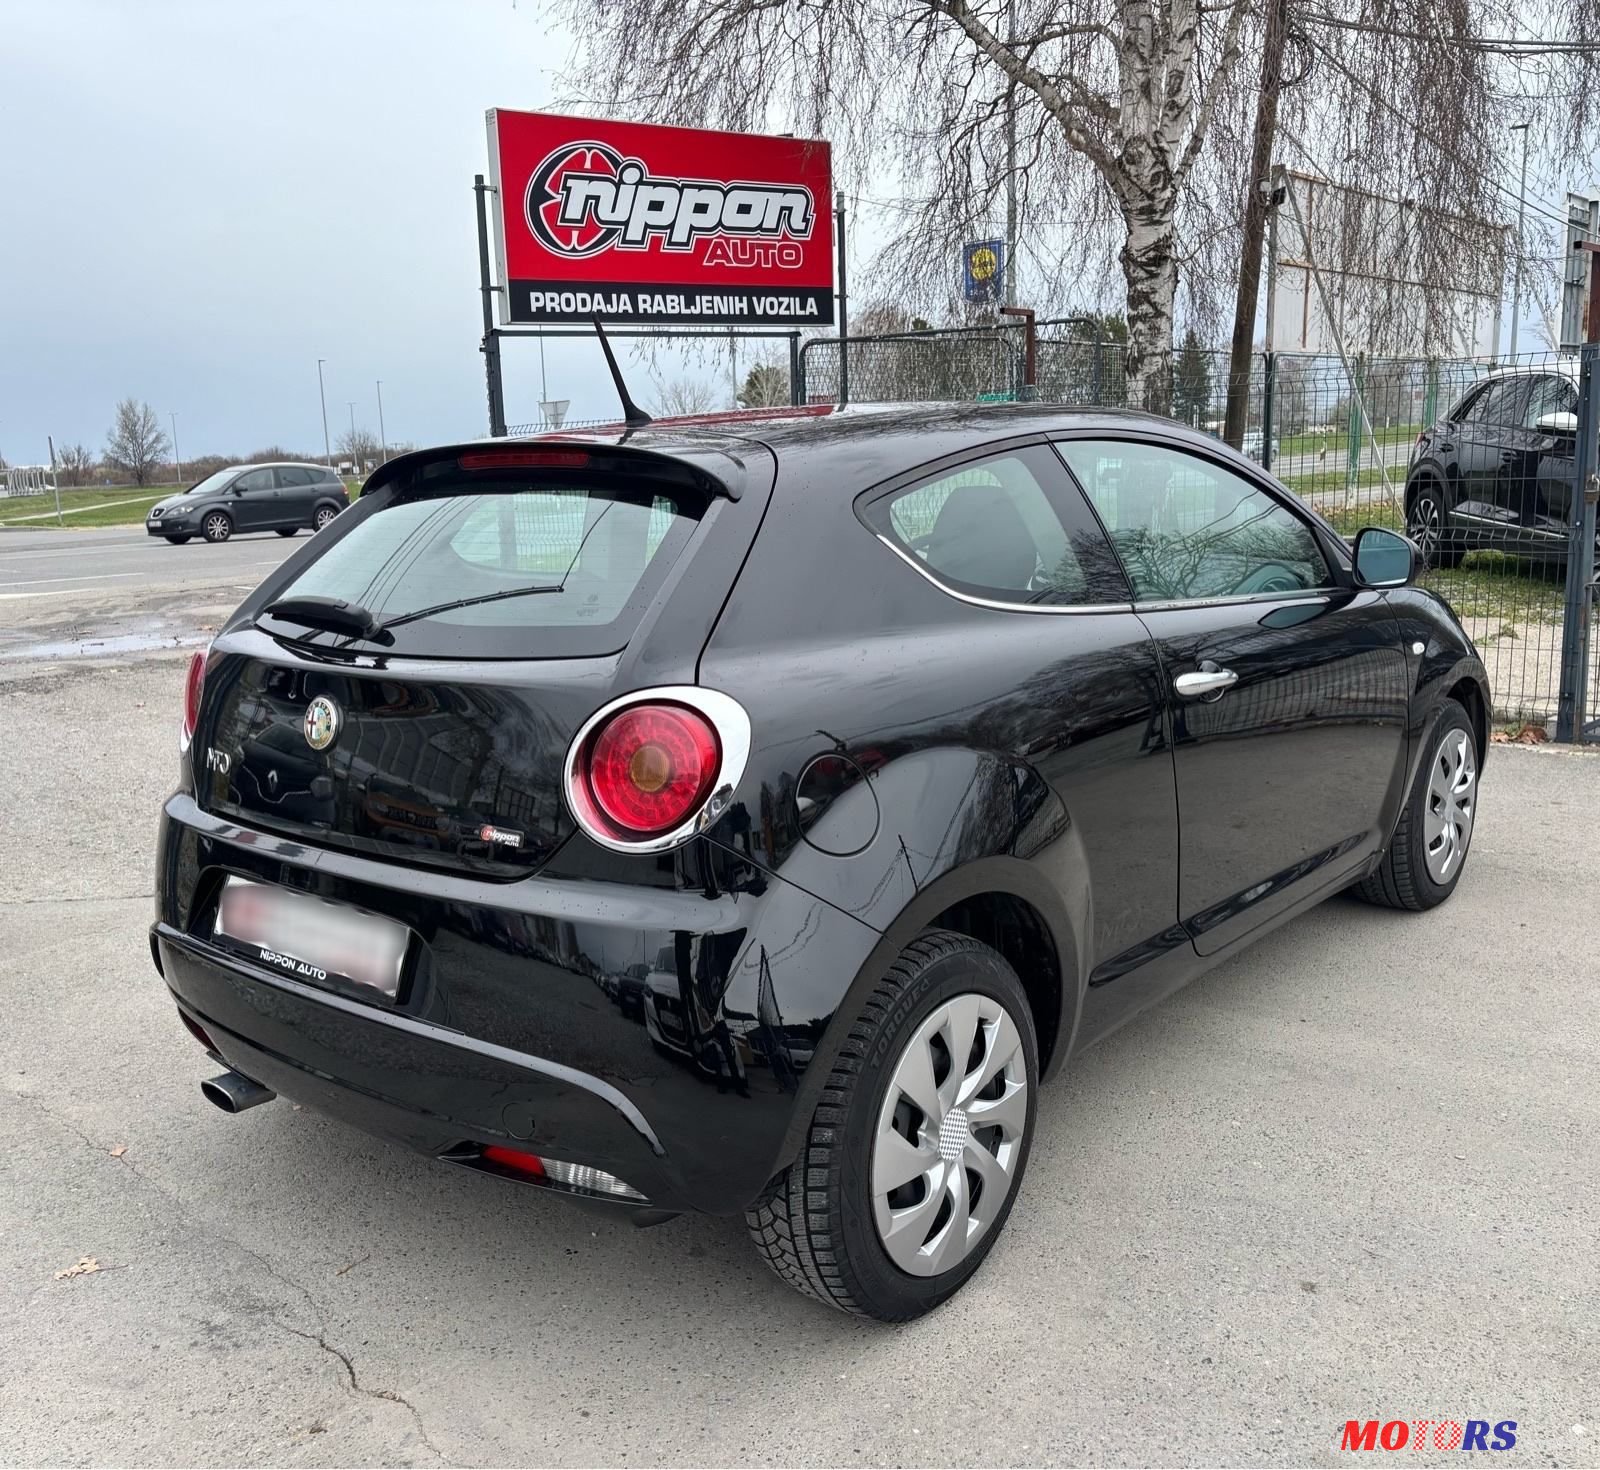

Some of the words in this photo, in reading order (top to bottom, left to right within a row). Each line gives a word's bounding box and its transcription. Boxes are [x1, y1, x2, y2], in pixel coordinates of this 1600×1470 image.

[560, 164, 813, 246] nippon
[703, 238, 803, 268] AUTO
[530, 291, 633, 315] PRODAJA
[638, 292, 748, 316] RABLJENIH
[752, 296, 819, 317] VOZILA
[260, 949, 296, 971] NIPPON
[296, 962, 327, 980] AUTO
